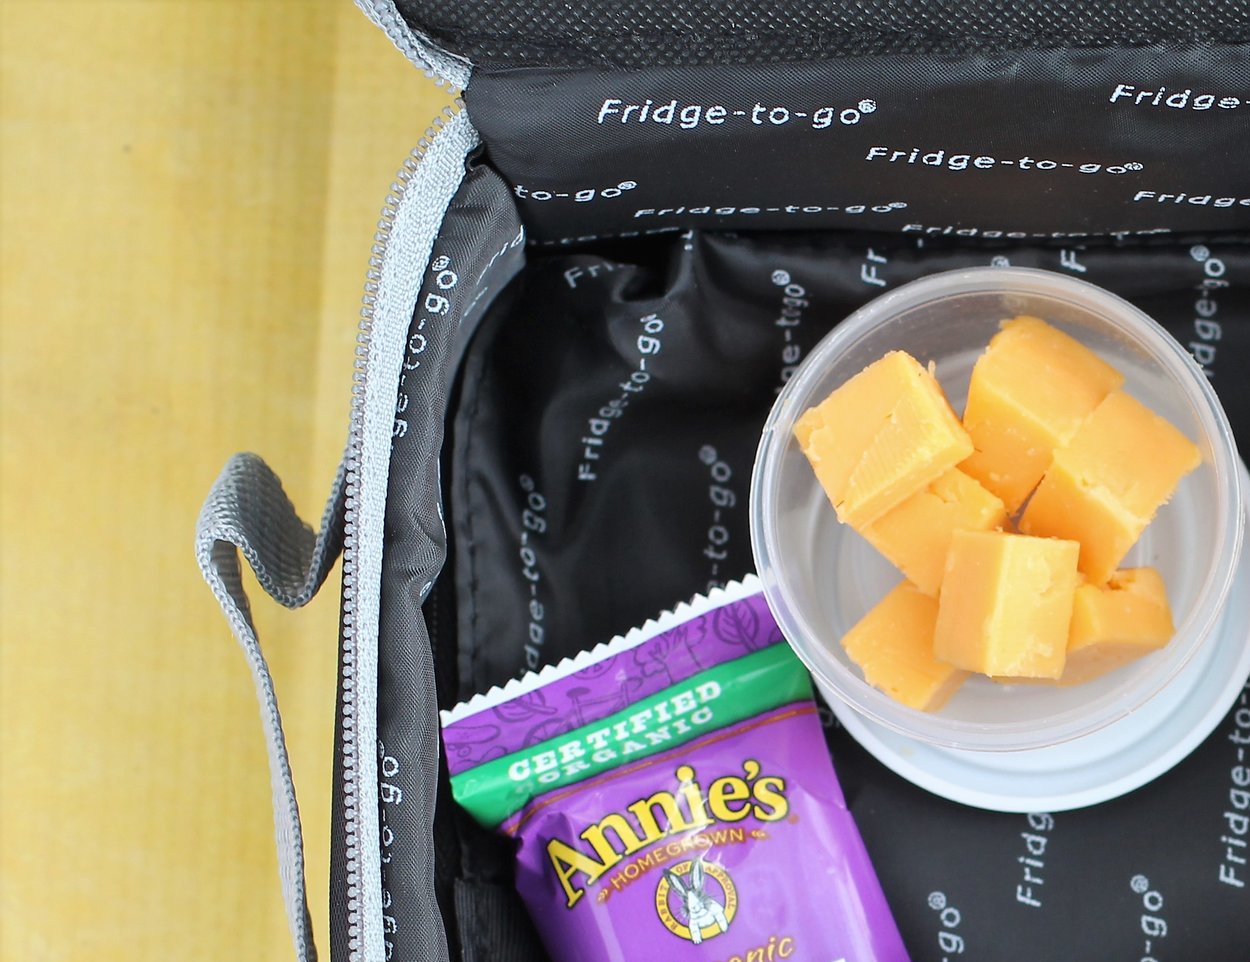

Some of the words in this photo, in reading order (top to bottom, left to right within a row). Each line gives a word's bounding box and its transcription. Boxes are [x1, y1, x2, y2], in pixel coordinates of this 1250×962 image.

[508, 681, 721, 781] CERTIFIED
[538, 706, 713, 783] ORGANIC
[546, 759, 790, 909] Annie's
[610, 827, 745, 891] HOMEGROWN
